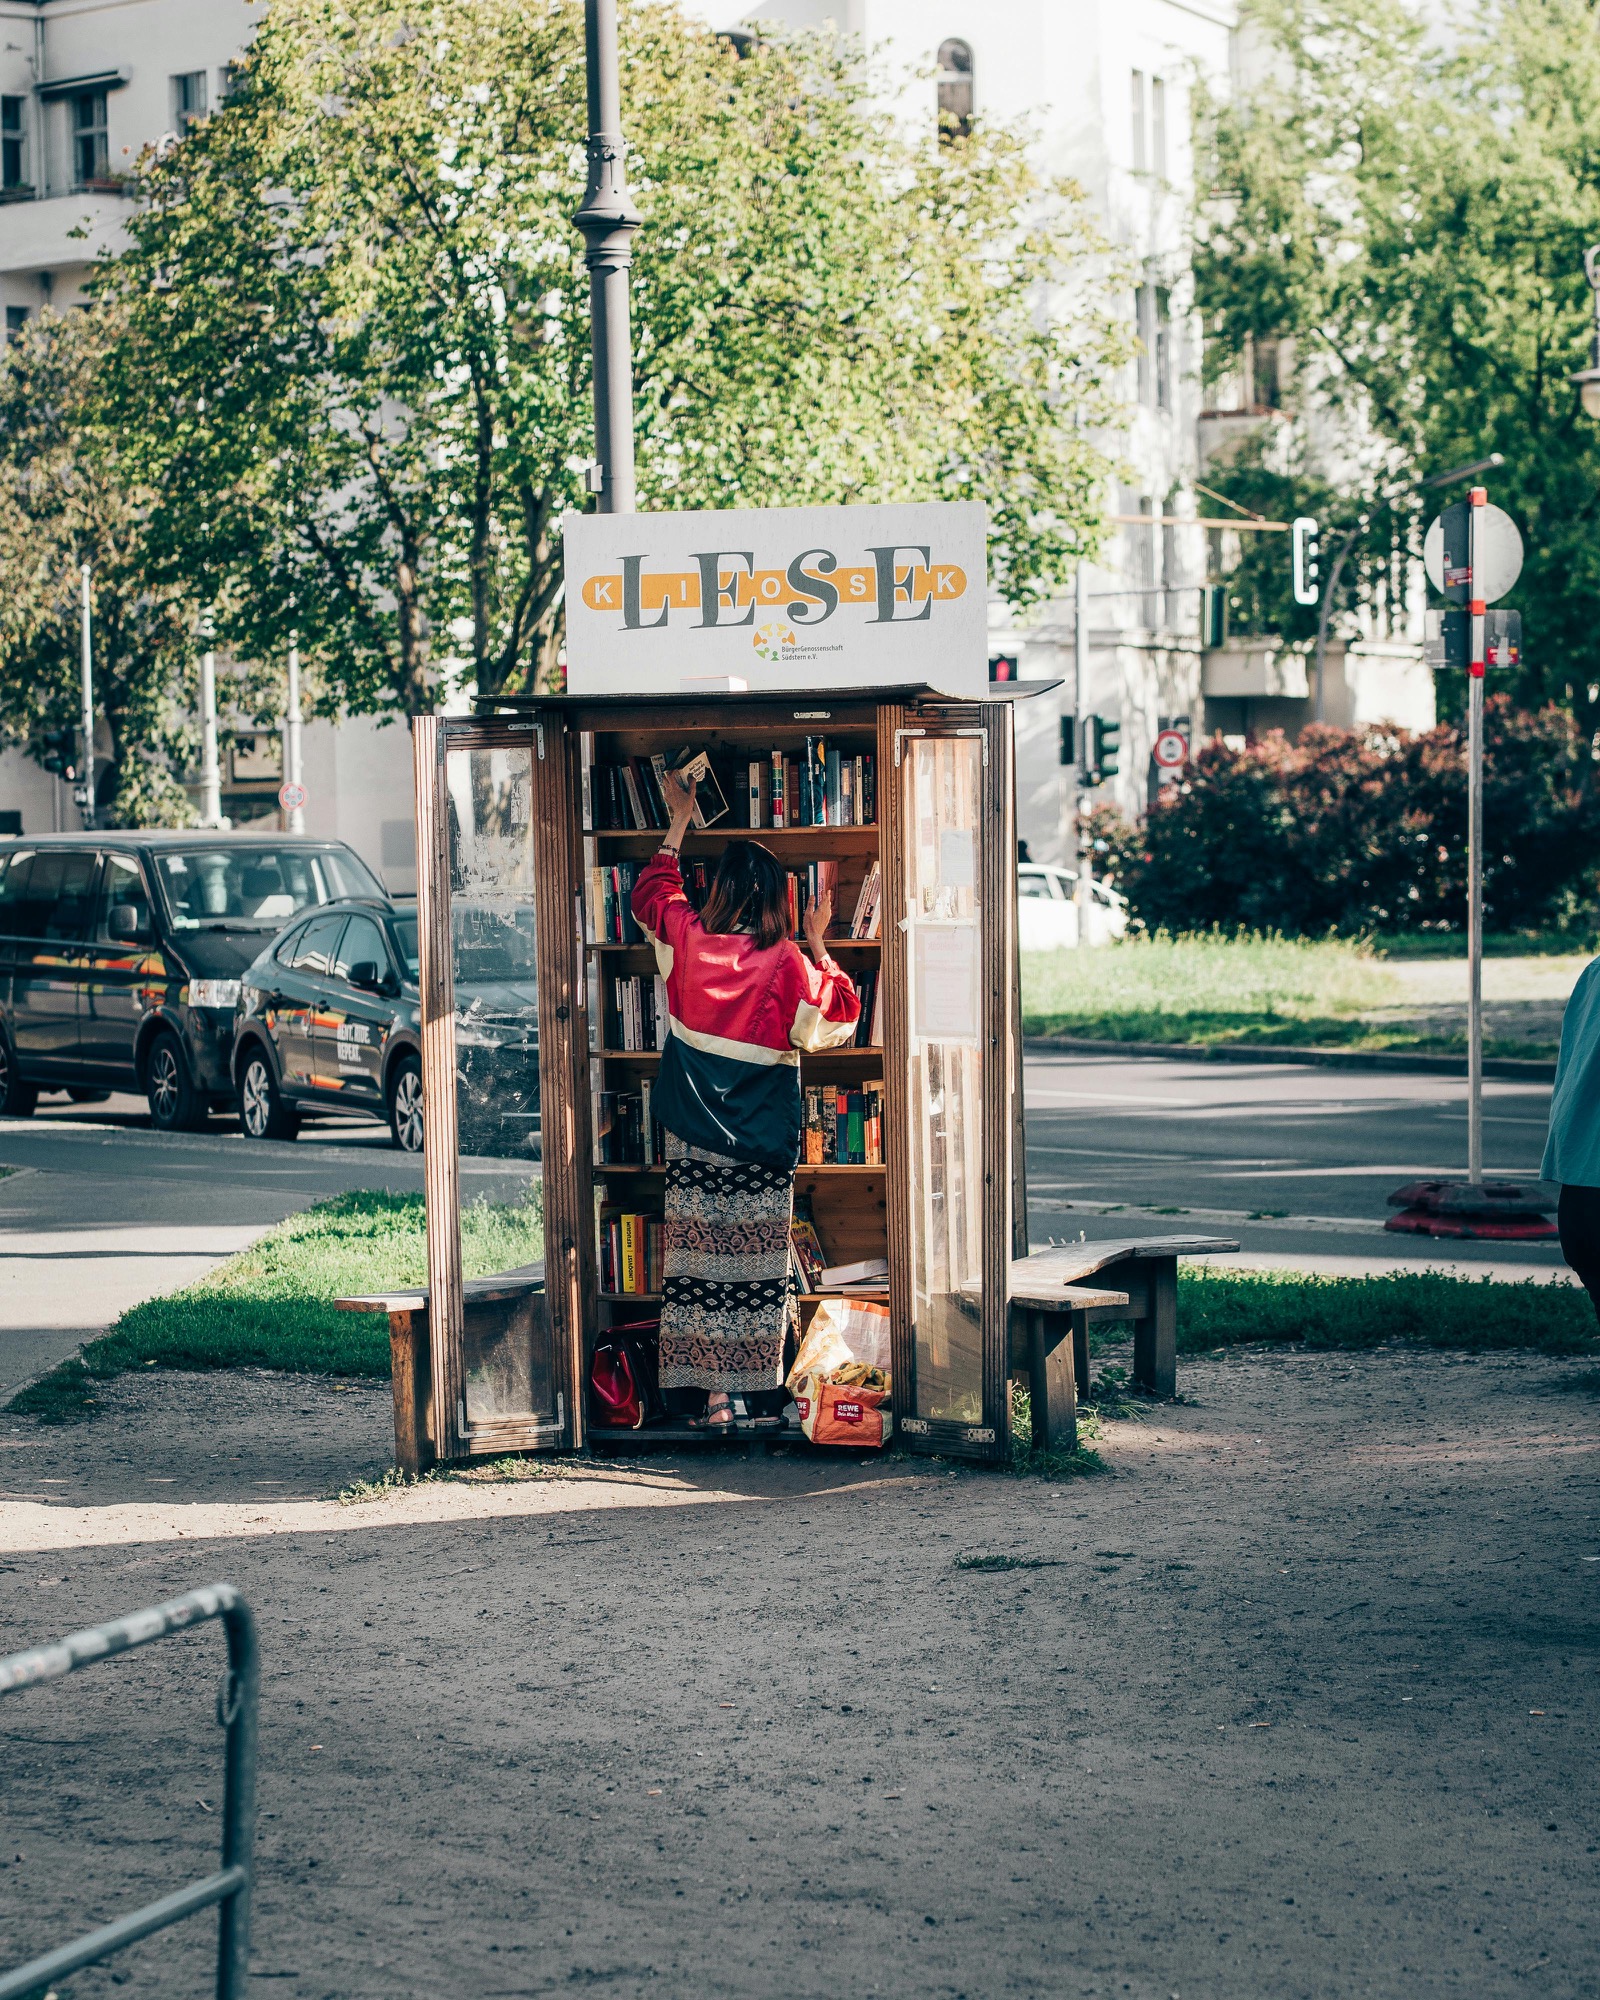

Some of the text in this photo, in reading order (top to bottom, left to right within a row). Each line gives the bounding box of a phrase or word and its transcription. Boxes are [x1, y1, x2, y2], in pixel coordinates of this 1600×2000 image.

[616, 545, 934, 631] LESE
[781, 645, 843, 654] BürgerGenossenschaft
[837, 1404, 859, 1412] REWE
